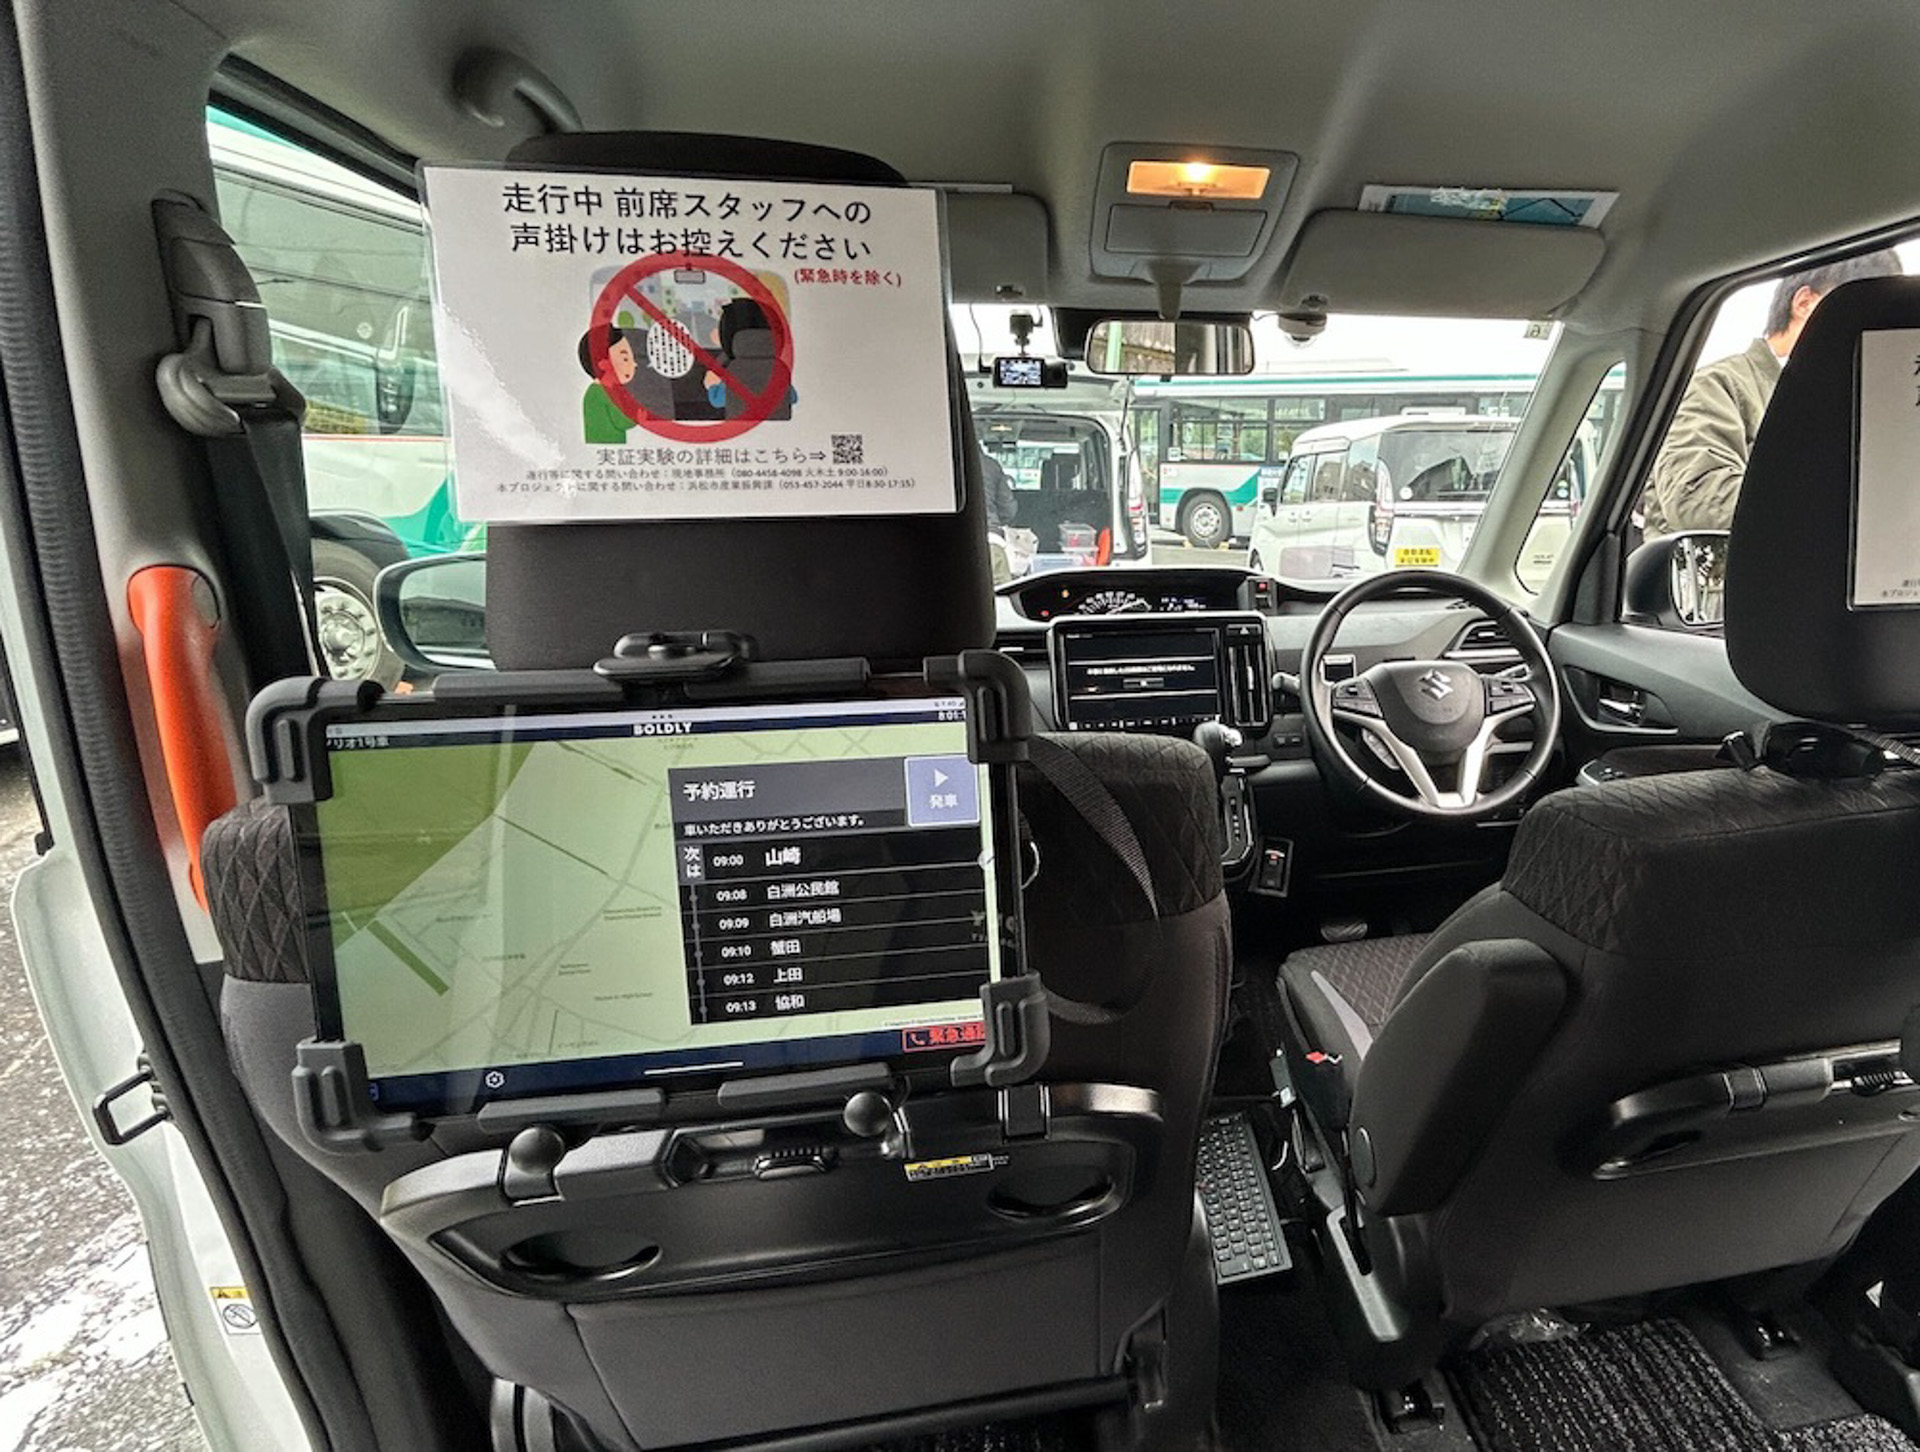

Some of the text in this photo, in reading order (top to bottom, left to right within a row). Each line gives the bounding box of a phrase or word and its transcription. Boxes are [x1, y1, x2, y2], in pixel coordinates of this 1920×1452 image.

[502, 182, 872, 225] 走行中 前席スタッフへの
[510, 222, 872, 261] 声掛けはお控えください
[633, 721, 692, 736] BOLDLY
[683, 780, 756, 801] 予約運行
[929, 793, 958, 809] 発車
[684, 814, 864, 837] 車いただきありがとうございます。
[684, 846, 701, 878] 次は
[713, 846, 801, 867] 09:00 山崎
[716, 889, 747, 902] 09:08
[719, 917, 750, 930] 09:09
[721, 945, 752, 958] 09:10
[723, 967, 803, 986] 09:12 上田
[726, 994, 805, 1013] 09:13 協和
